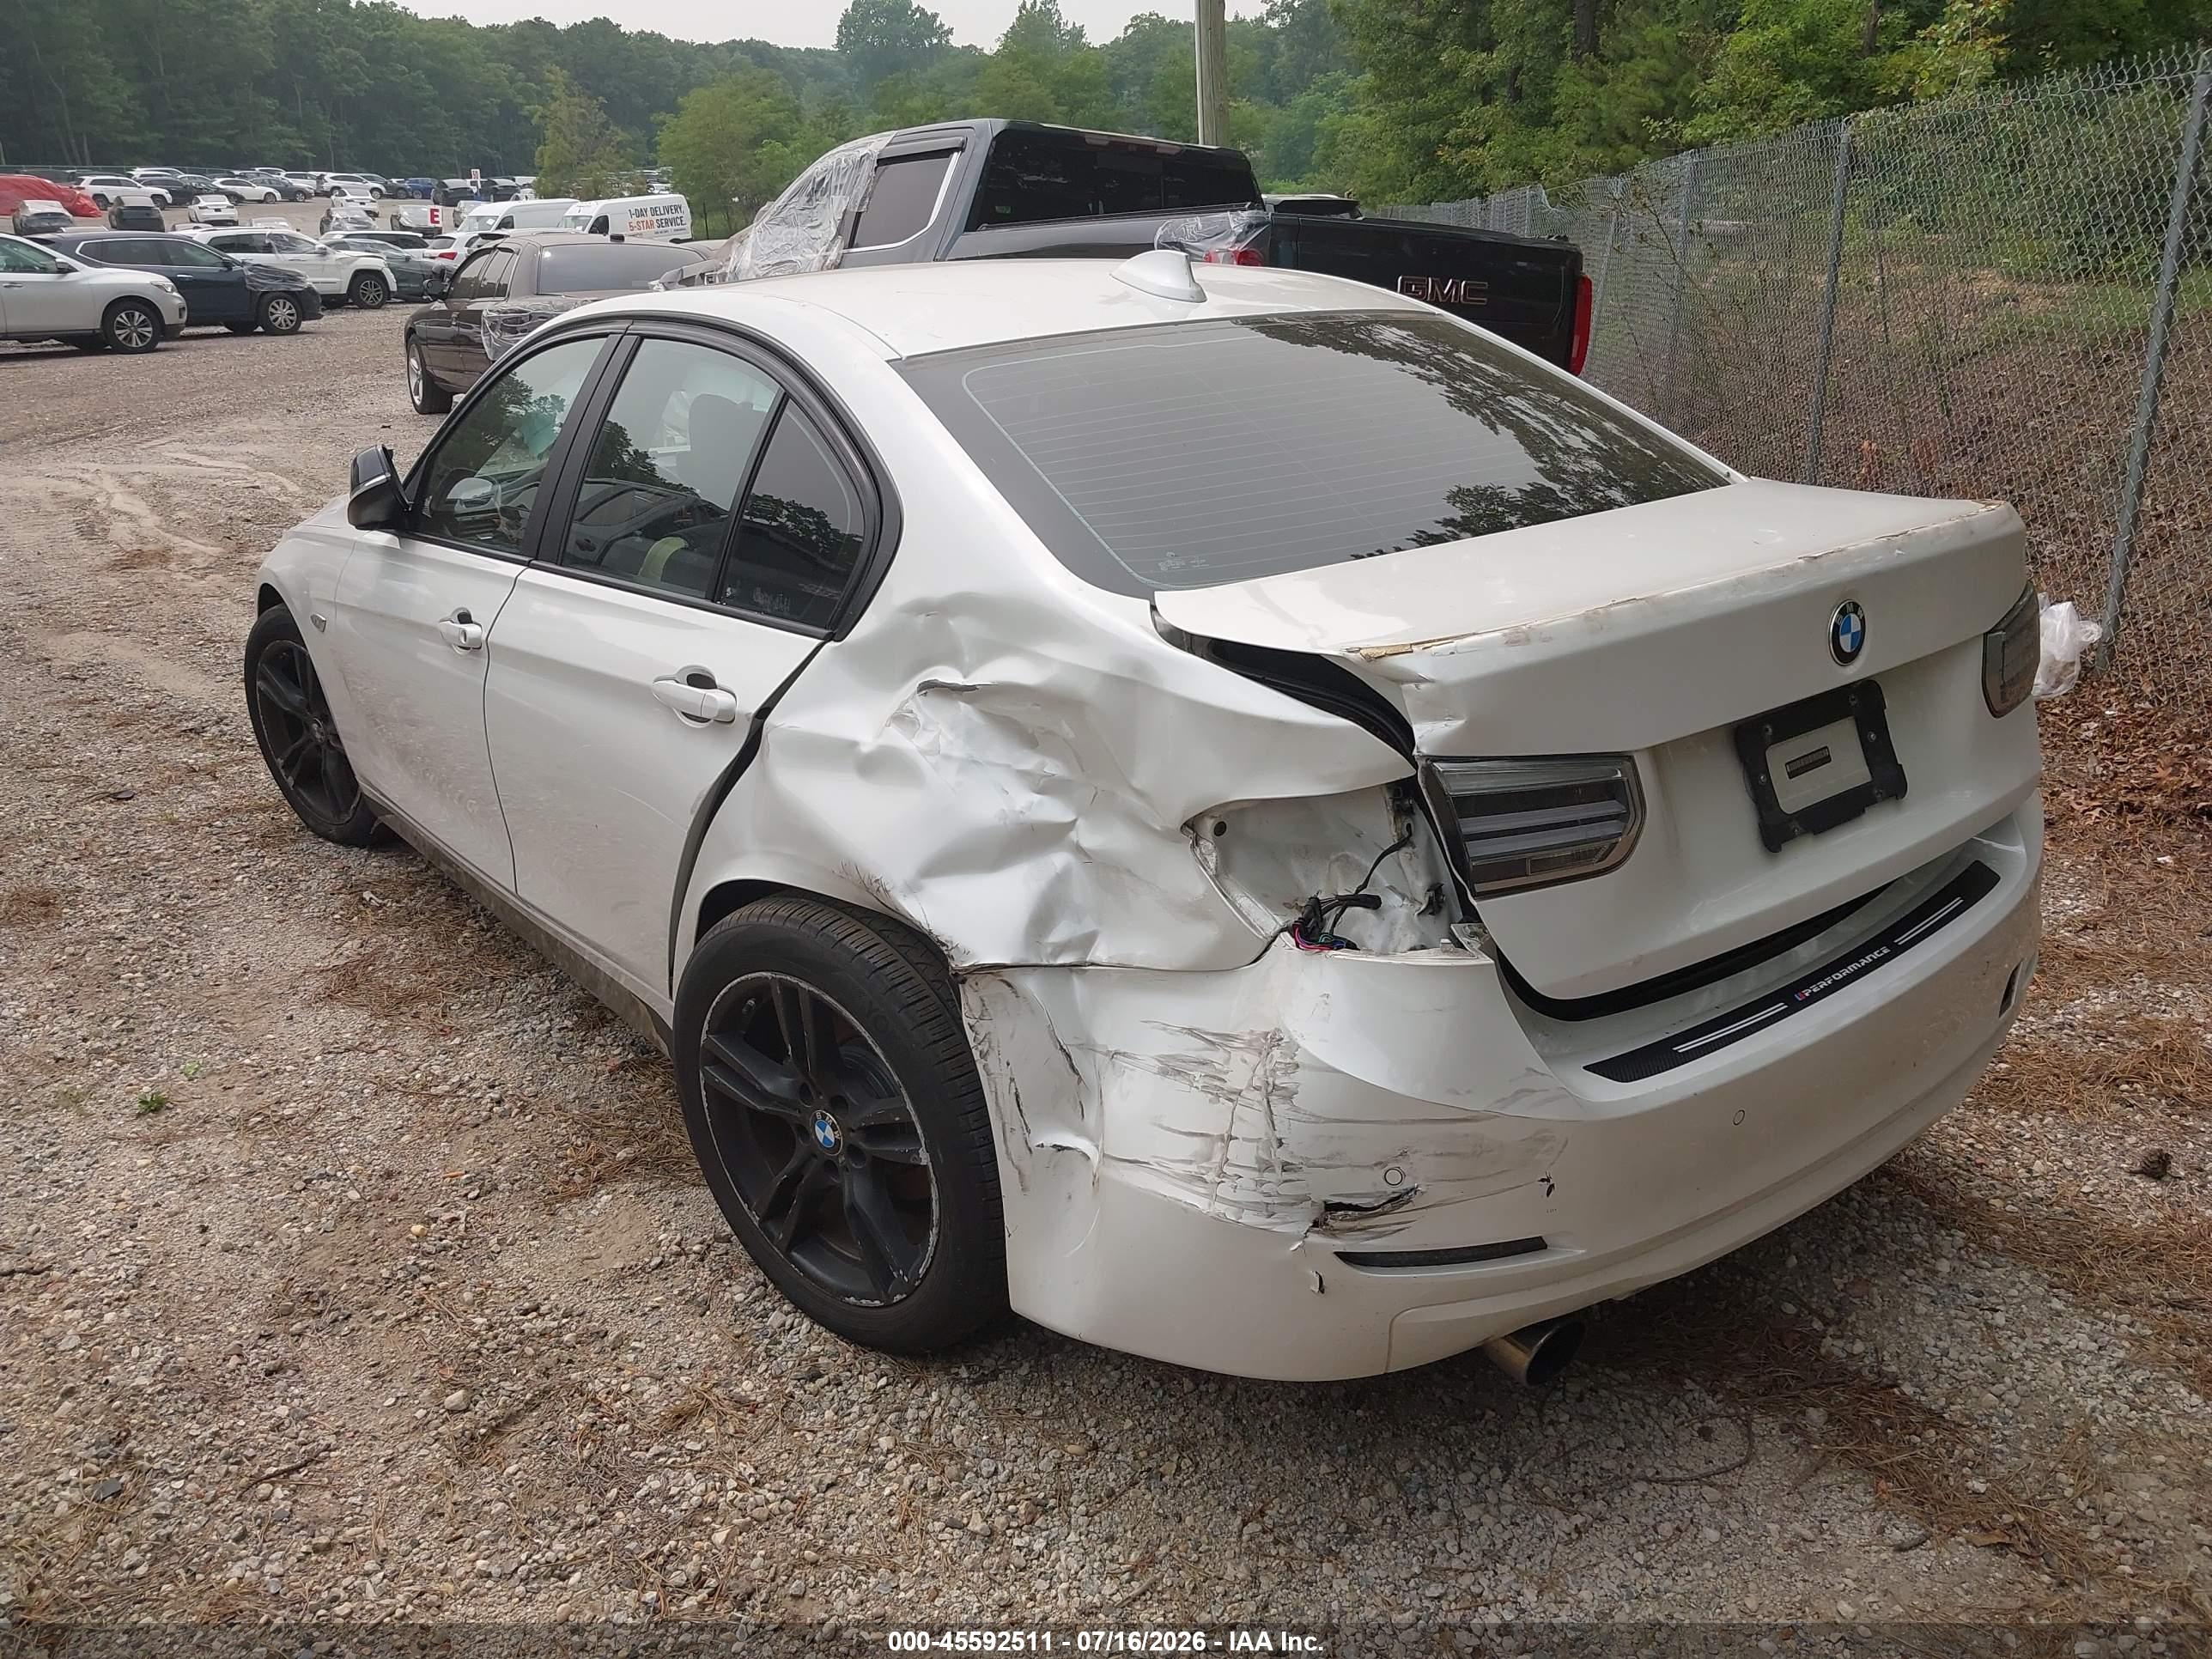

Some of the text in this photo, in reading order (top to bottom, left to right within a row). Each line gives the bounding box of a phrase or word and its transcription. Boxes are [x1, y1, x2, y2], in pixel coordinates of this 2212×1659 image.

[430, 209, 441, 224] E
[629, 204, 685, 219] 1-DAY DELIVERY,
[629, 220, 655, 232] 5-STAR
[1397, 276, 1488, 305] GMC
[1834, 602, 1864, 626] BMW
[1802, 945, 1891, 997] PERFORMANCE
[816, 1112, 842, 1140] BMW
